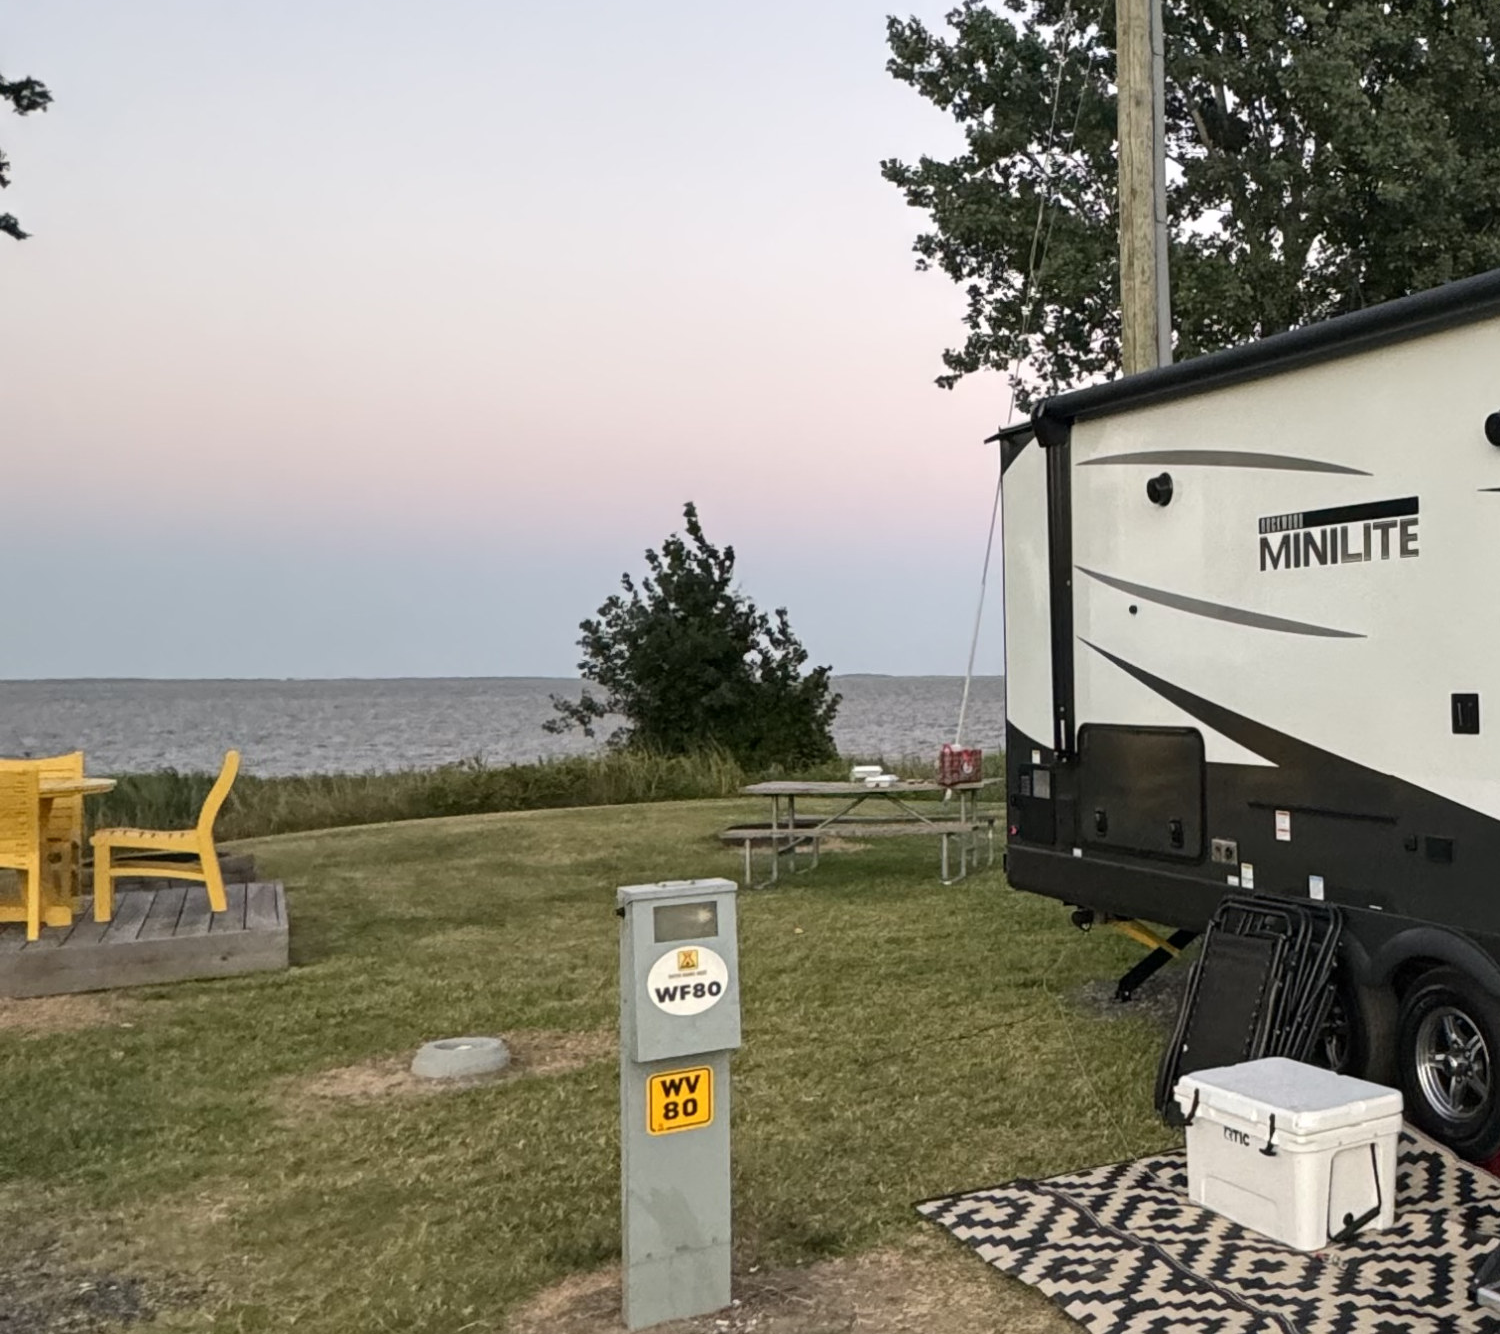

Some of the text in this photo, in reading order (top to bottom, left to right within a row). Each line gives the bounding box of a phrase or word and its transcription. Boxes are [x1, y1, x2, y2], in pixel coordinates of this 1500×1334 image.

[1259, 517, 1420, 572] MINILITE
[654, 980, 722, 1004] WF80
[660, 1074, 701, 1099] WV
[662, 1098, 698, 1121] 80
